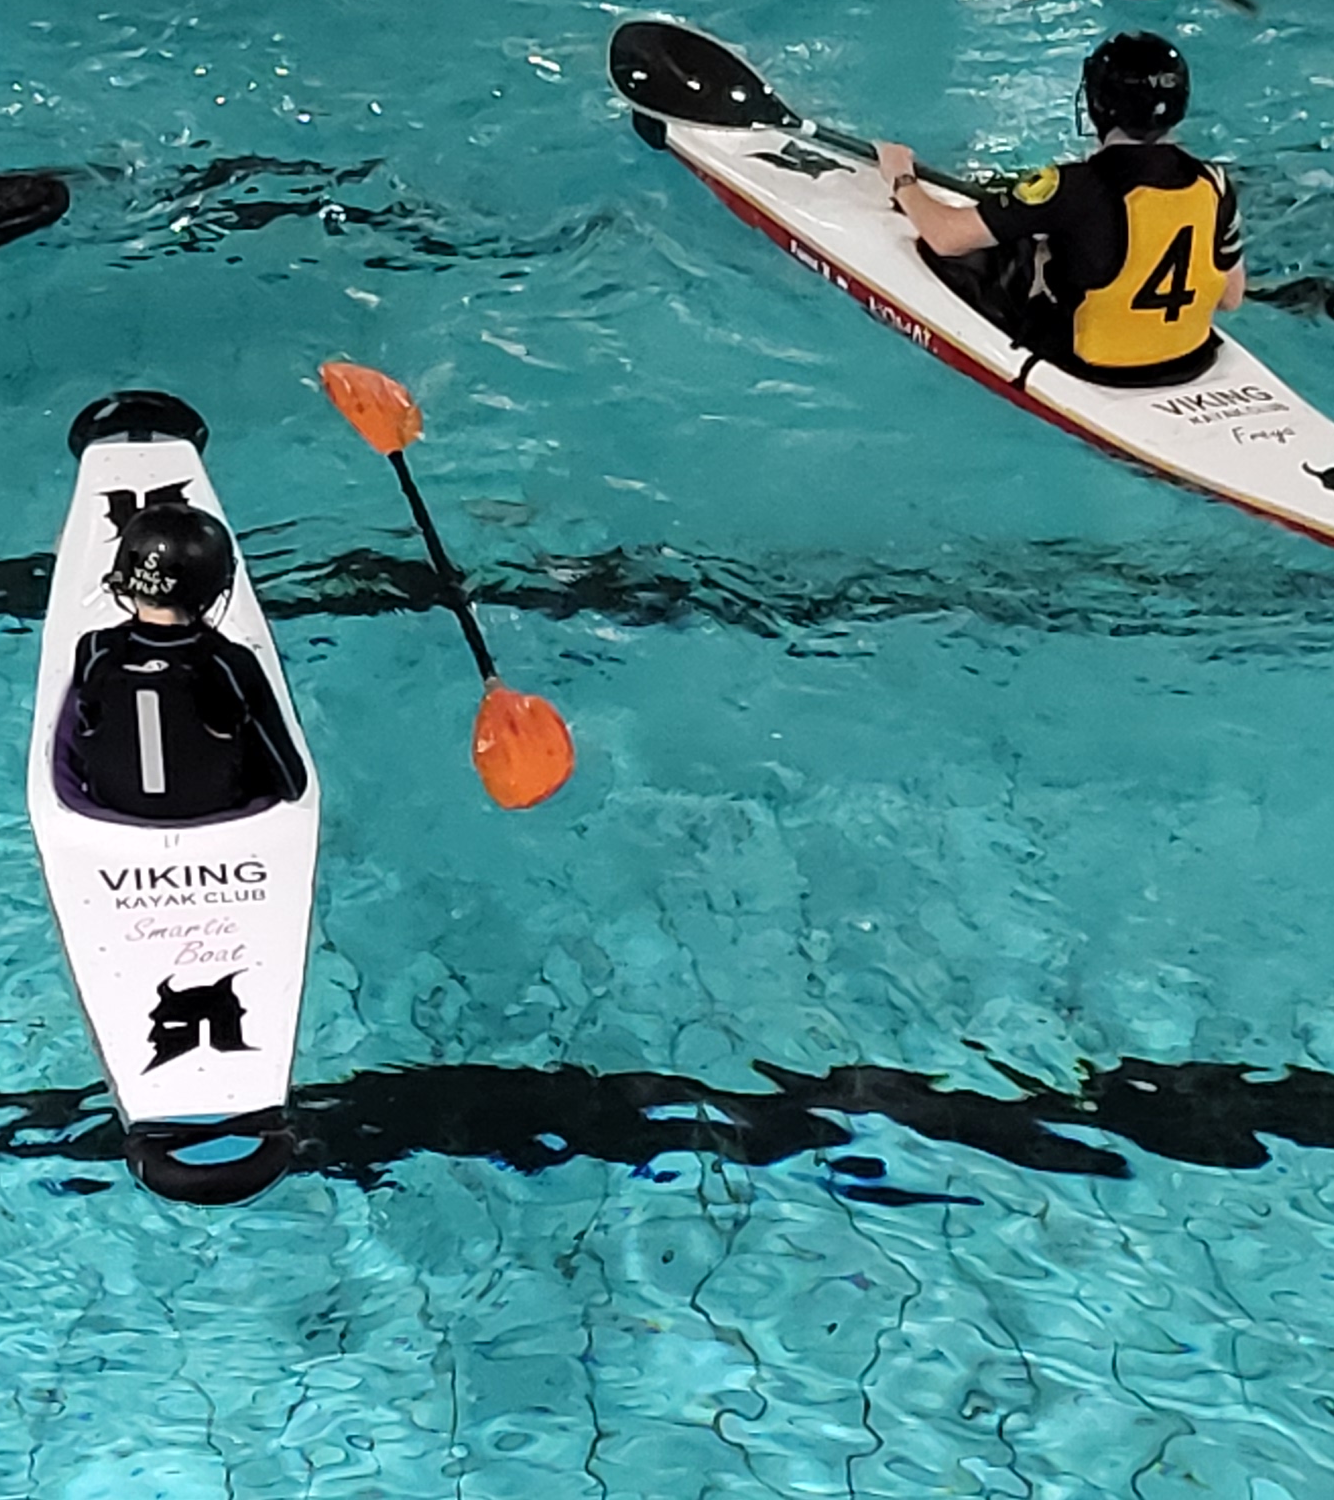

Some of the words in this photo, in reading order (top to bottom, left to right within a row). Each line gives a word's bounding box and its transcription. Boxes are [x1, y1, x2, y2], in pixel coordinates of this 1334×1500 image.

[1130, 224, 1197, 324] 4
[1151, 386, 1274, 416] VIKING
[98, 861, 268, 891] VIKING
[116, 893, 197, 910] KAYAK
[203, 889, 267, 904] CLUB
[124, 916, 239, 942] Smartie
[173, 940, 247, 966] Boat
